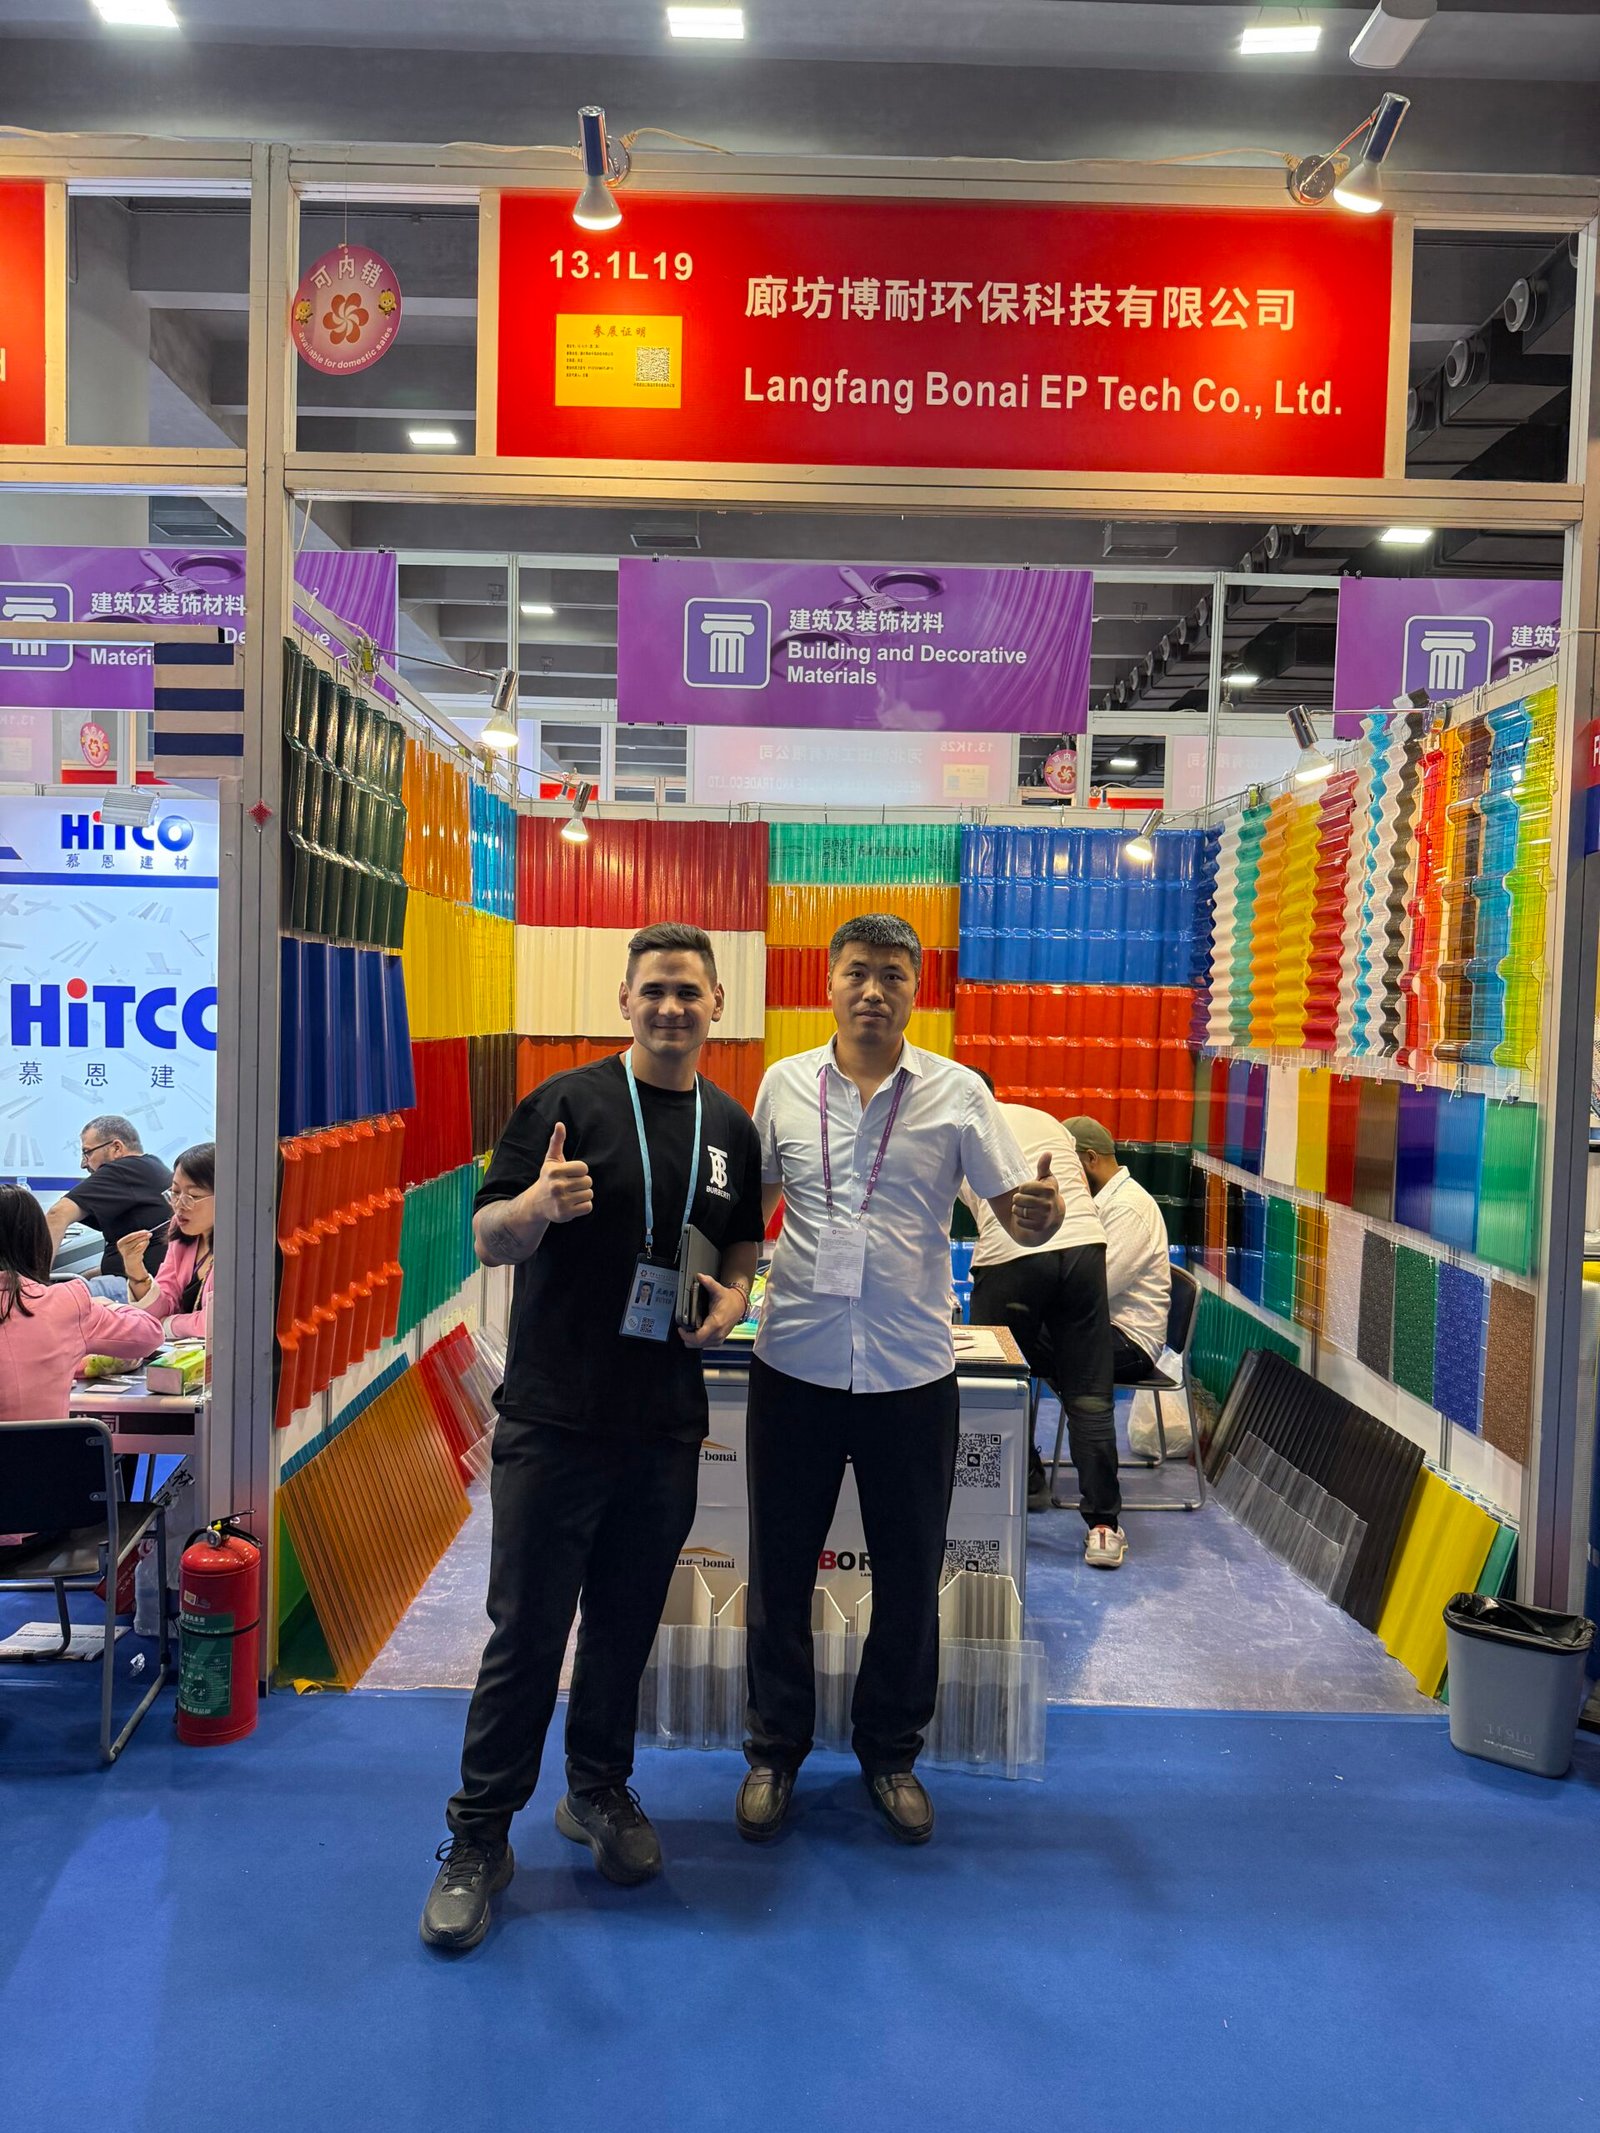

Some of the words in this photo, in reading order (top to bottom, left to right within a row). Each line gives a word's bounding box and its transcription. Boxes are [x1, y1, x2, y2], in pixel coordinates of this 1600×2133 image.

[310, 254, 383, 289] 可内销
[549, 249, 694, 281] 13.1L19
[744, 274, 1295, 331] 廊坊博耐环保科技有限公司
[298, 331, 324, 363] available
[324, 358, 336, 369] for
[337, 349, 378, 369] domestic
[376, 326, 393, 350] sales
[744, 366, 913, 414] Langfang
[926, 370, 1029, 409] Bonai
[1041, 374, 1088, 409] EP
[1098, 375, 1181, 412] Tech
[1193, 377, 1262, 420] Co.,
[1275, 379, 1342, 415] Ltd.
[91, 592, 246, 616] 建筑及装饰材料
[789, 608, 944, 634] 建筑及装饰材料
[1511, 625, 1558, 647] 建筑
[91, 648, 155, 666] Materi
[787, 641, 871, 664] Building
[877, 645, 914, 662] and
[920, 645, 1027, 664] Decorative
[787, 665, 877, 685] Materials
[65, 853, 189, 871] 慕恩建材
[19, 1060, 176, 1089] 慕恩建
